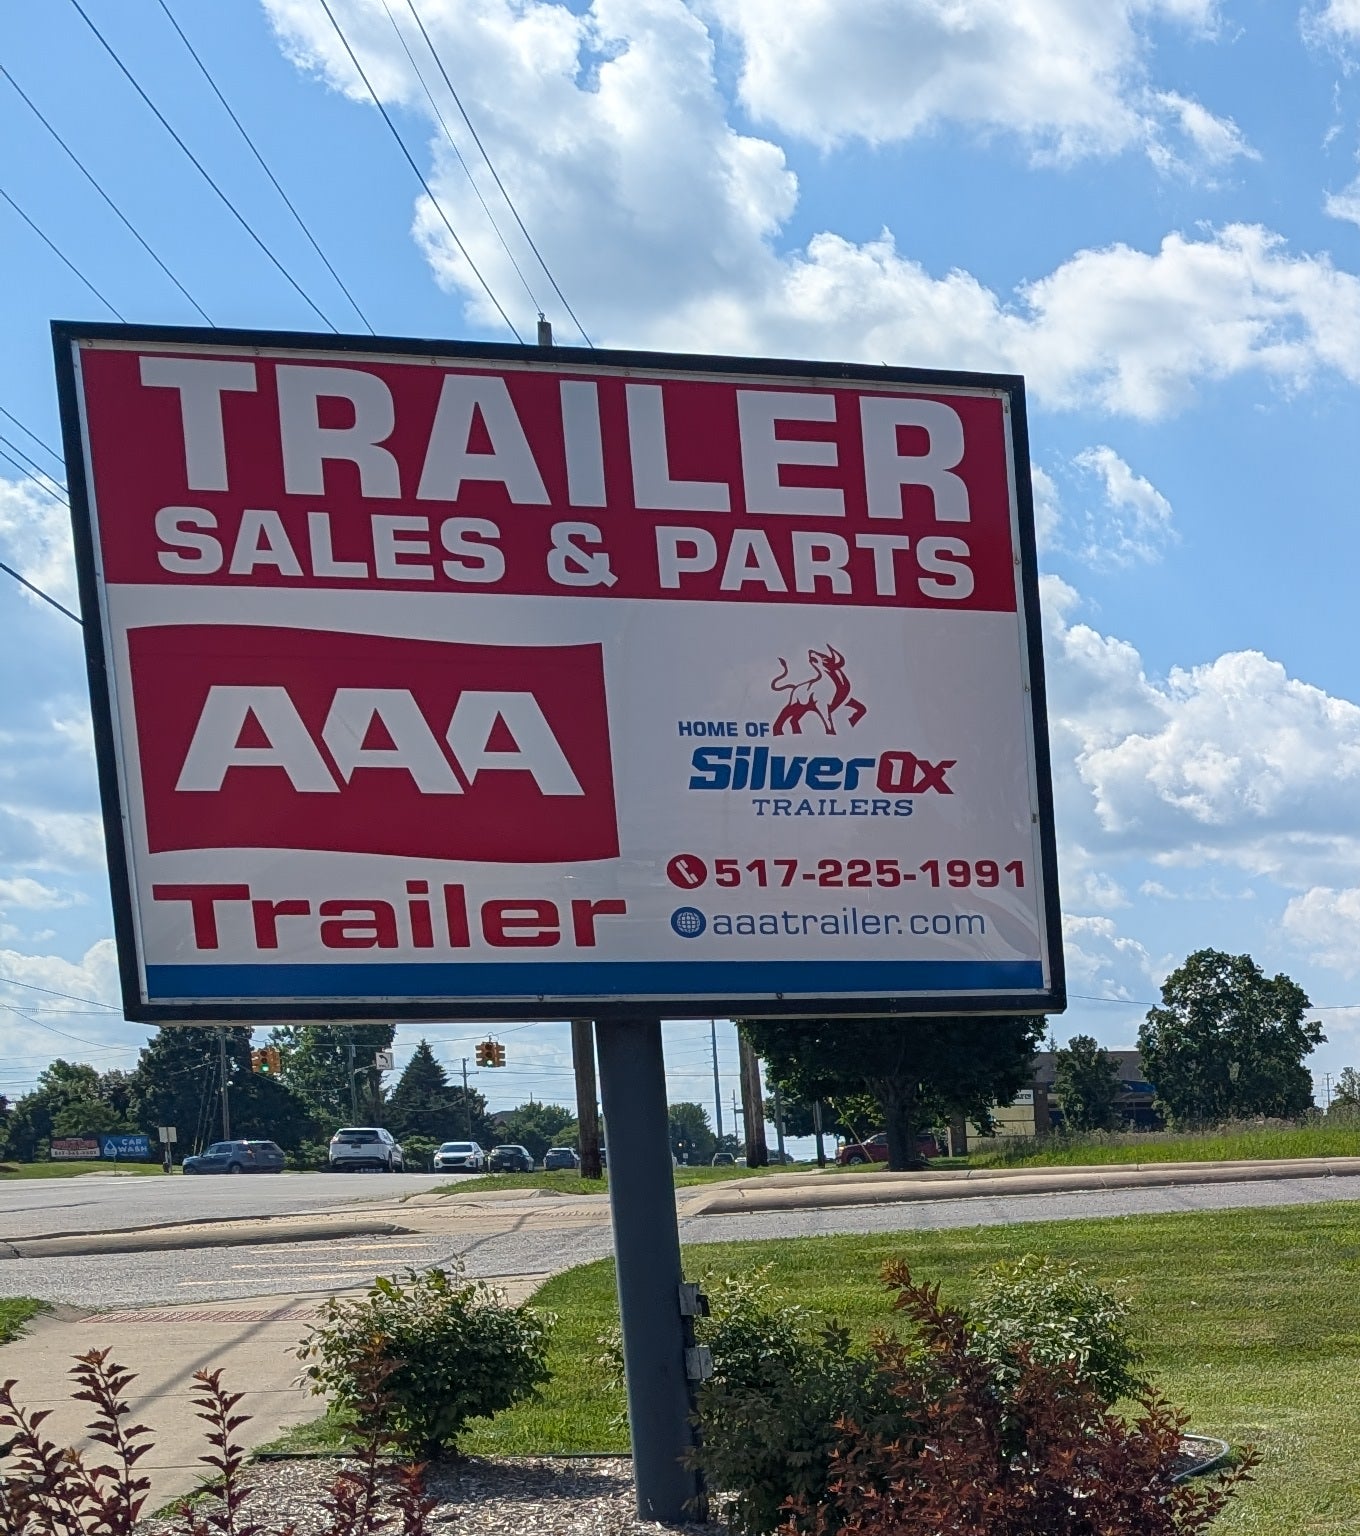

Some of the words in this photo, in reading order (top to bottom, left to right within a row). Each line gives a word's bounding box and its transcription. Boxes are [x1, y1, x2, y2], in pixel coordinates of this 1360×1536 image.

[139, 356, 971, 522] TRAILER
[154, 507, 505, 583] SALES
[547, 521, 618, 587] &
[656, 526, 975, 600] PARTS
[174, 685, 585, 796] AAA
[678, 721, 738, 737] HOME
[745, 722, 770, 738] OF
[752, 799, 913, 816] TRAILERS
[715, 859, 1025, 888] 517-225-1991
[153, 880, 627, 949] Trailer
[713, 907, 985, 935] aaatrailer.com
